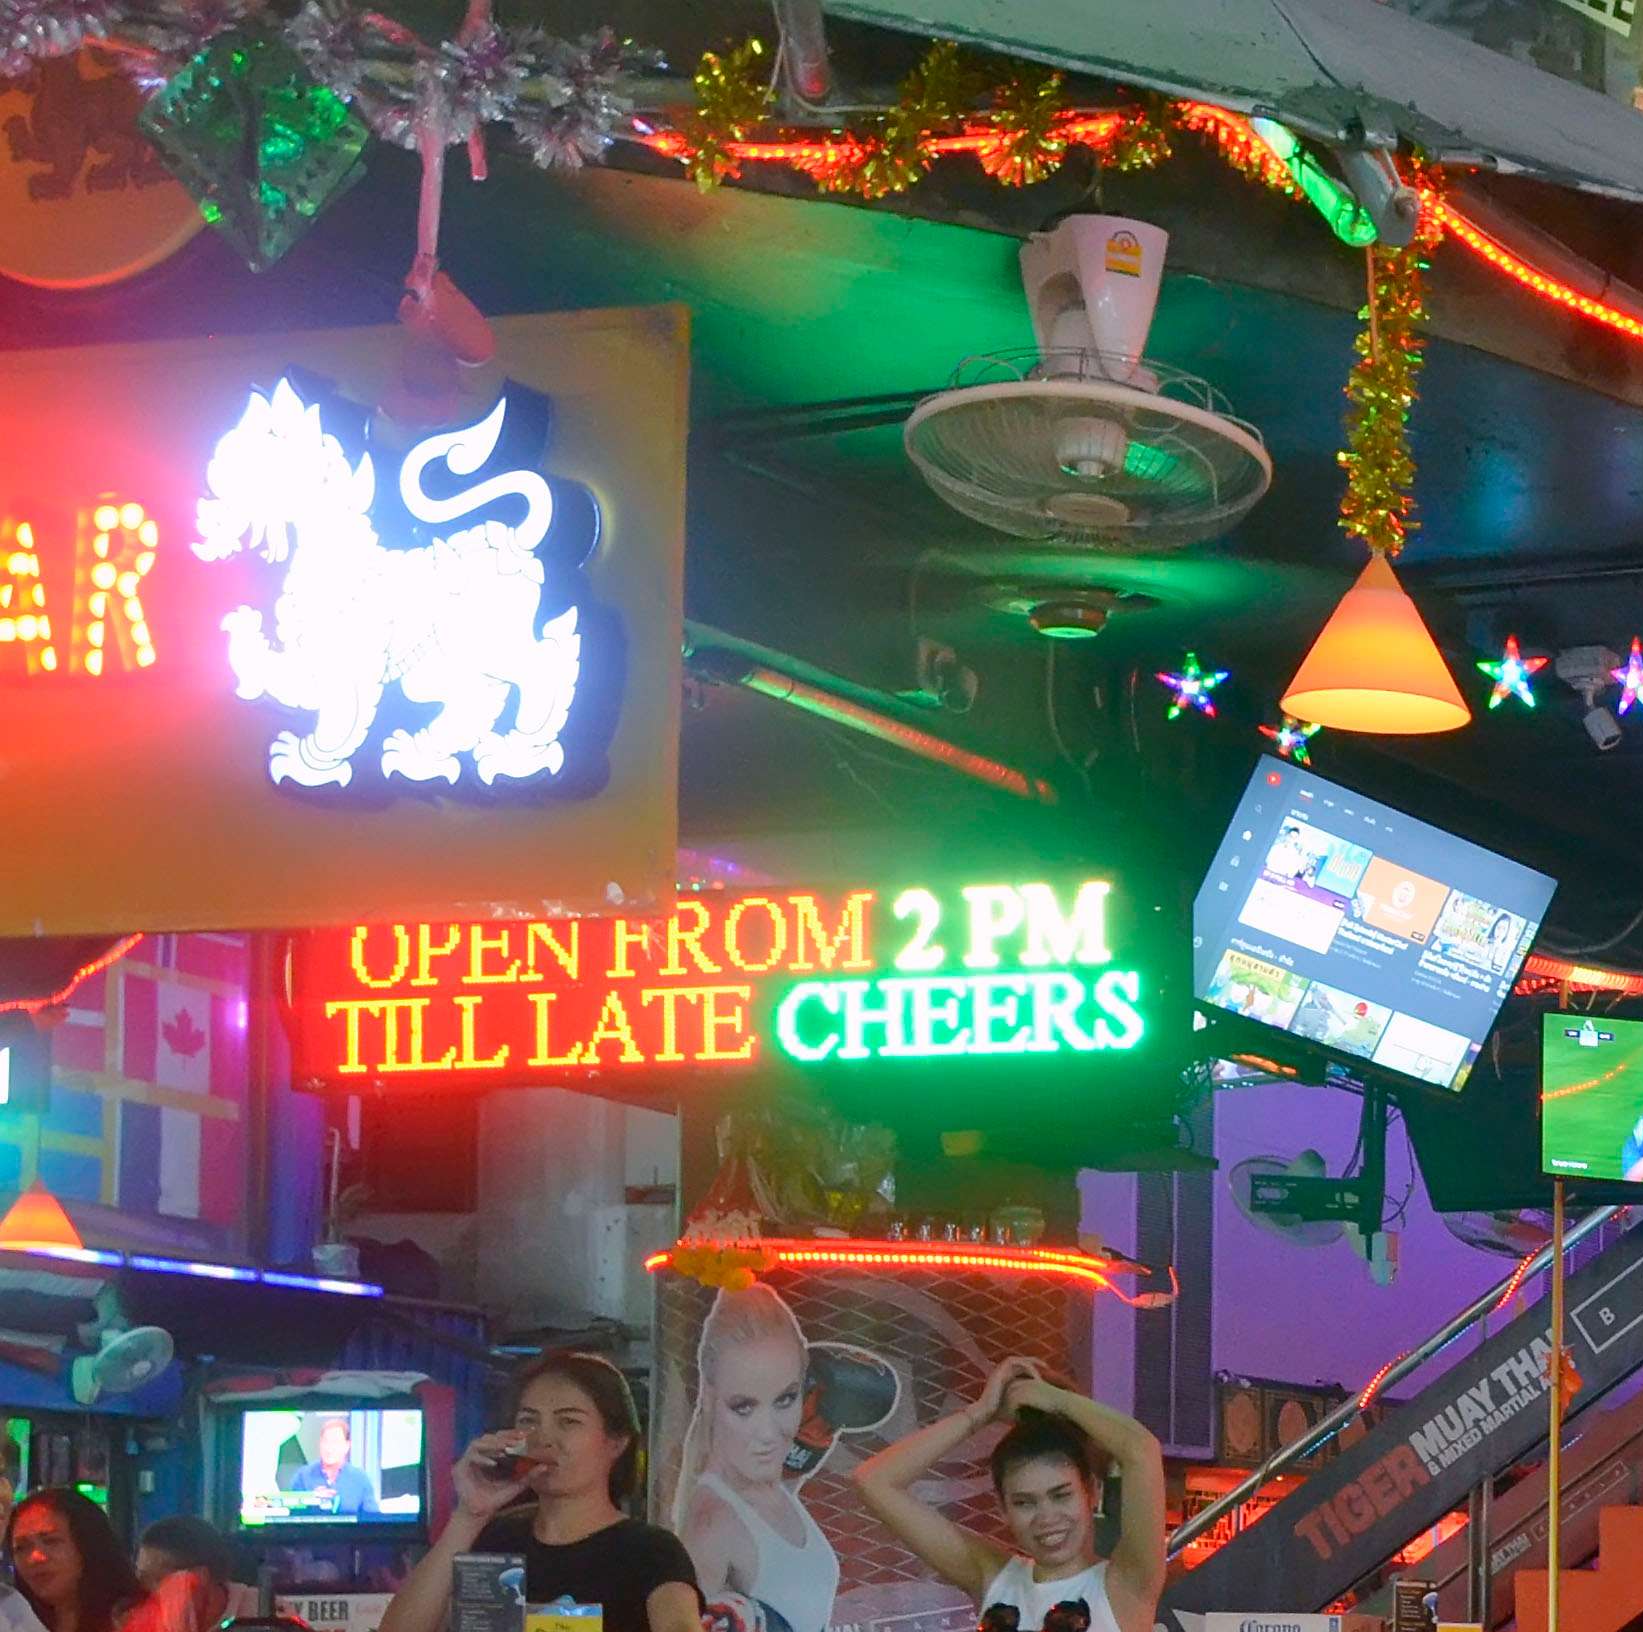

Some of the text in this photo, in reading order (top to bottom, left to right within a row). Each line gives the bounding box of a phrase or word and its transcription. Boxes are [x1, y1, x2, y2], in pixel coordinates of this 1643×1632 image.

[350, 880, 1112, 989] OPEN FROM 2 PM
[325, 970, 1146, 1074] TILL LATE CHEERS
[1408, 1327, 1558, 1464] MUAY THA
[1437, 1427, 1483, 1469] MIXED
[1479, 1383, 1543, 1436] MARTIAL
[1293, 1445, 1435, 1561] TIGER
[308, 1600, 349, 1621] BEER
